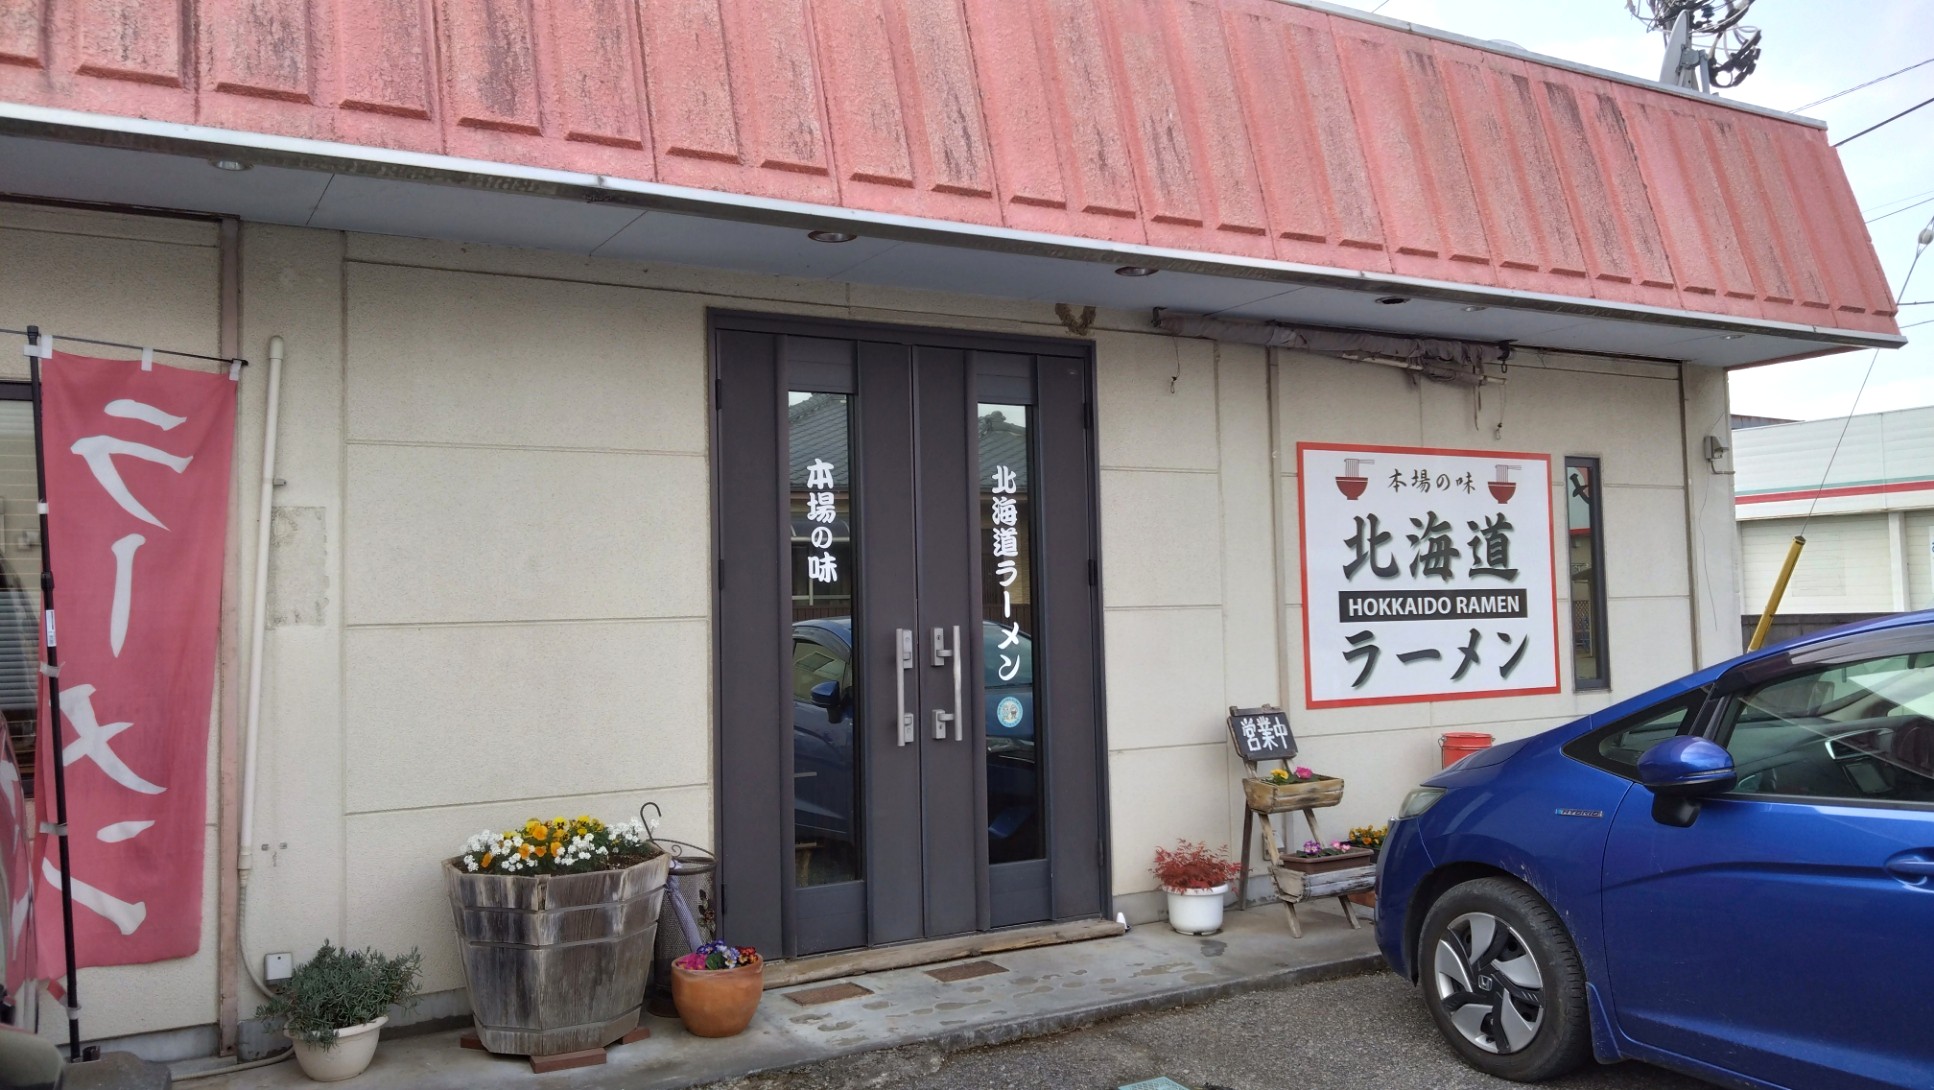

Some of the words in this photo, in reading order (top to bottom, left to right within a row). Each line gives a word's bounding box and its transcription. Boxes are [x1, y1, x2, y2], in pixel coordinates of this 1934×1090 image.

[1388, 469, 1476, 494] 本場の味
[807, 458, 838, 583] 本場の味
[1342, 511, 1519, 581] 北海道
[992, 465, 1020, 681] 北海道ラーメン
[1349, 597, 1451, 616] HOKKAIDO
[1456, 595, 1520, 614] RAMEN
[1342, 628, 1528, 688] ラーメン
[1240, 716, 1288, 751] 営業中
